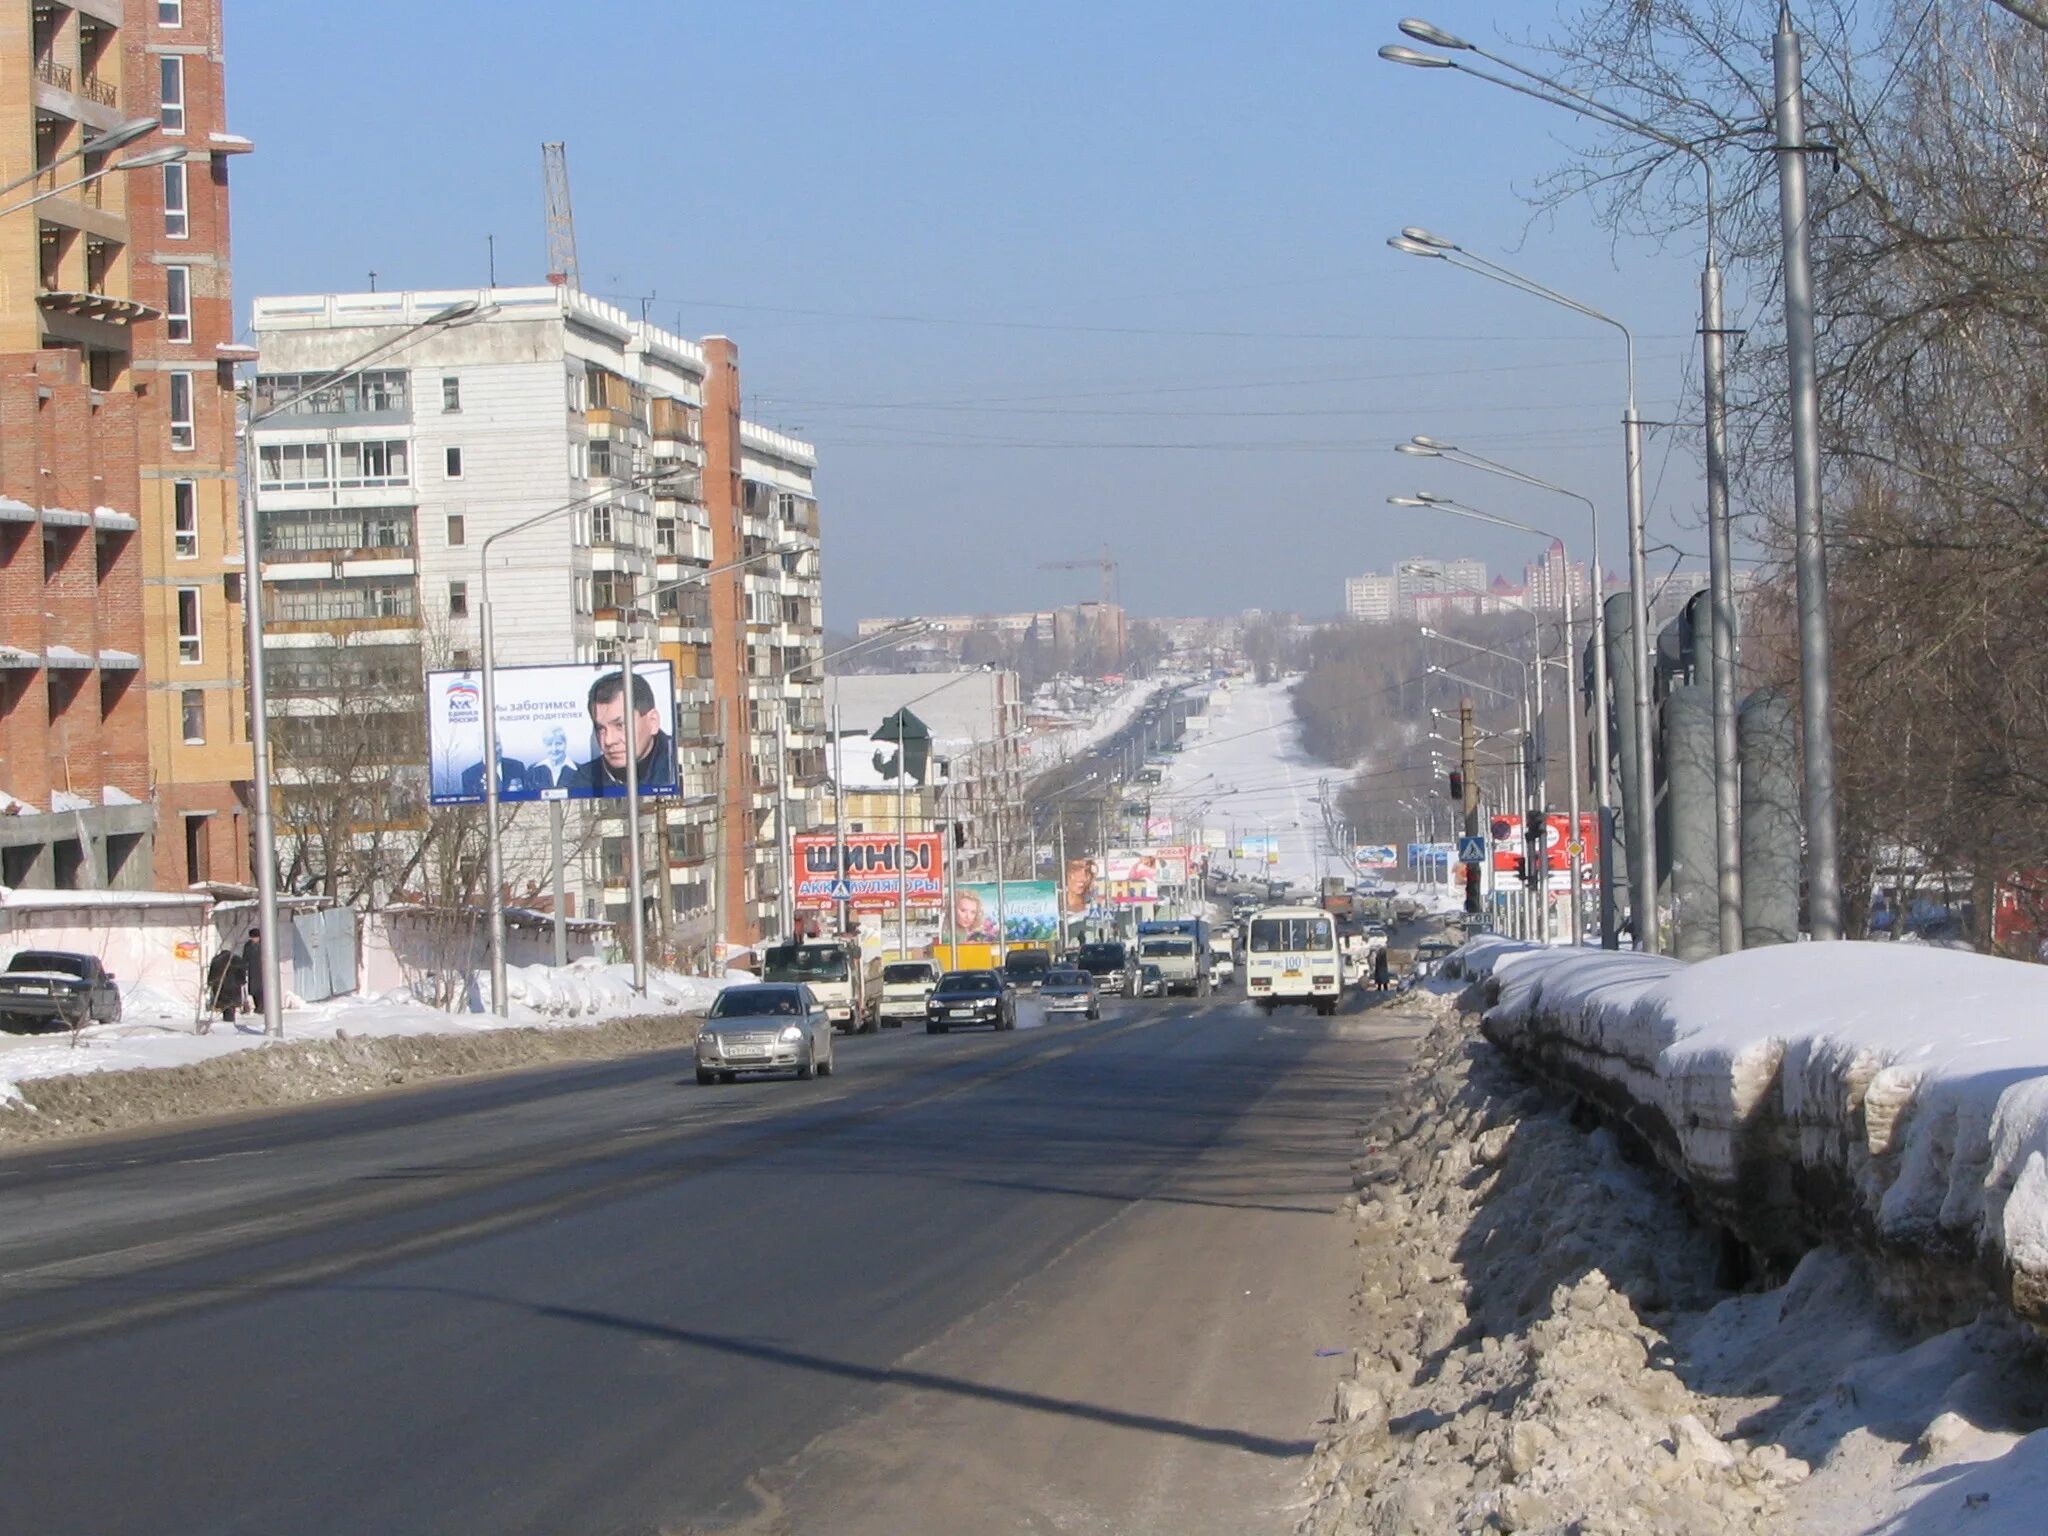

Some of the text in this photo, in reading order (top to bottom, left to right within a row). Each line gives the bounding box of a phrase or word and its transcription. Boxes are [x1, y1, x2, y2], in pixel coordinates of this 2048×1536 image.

[510, 699, 576, 712] заботимся
[533, 711, 583, 722] родителях
[805, 843, 931, 873] ШИНЫ
